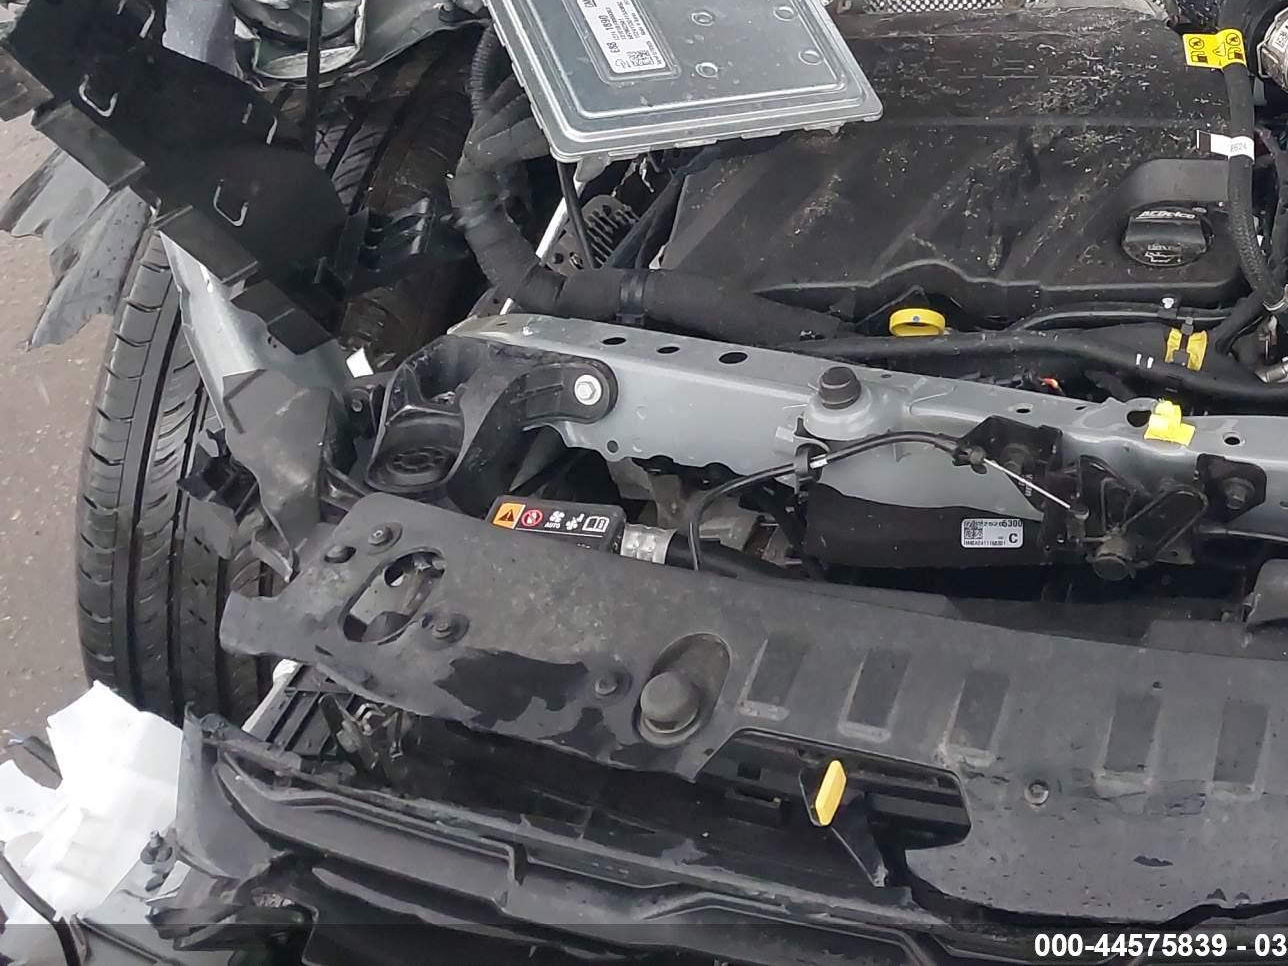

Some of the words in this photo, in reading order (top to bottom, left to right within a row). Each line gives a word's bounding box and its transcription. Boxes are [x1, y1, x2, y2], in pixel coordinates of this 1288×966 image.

[1137, 210, 1196, 219] ACDelco
[543, 521, 561, 529] AUTO
[1009, 533, 1018, 544] C
